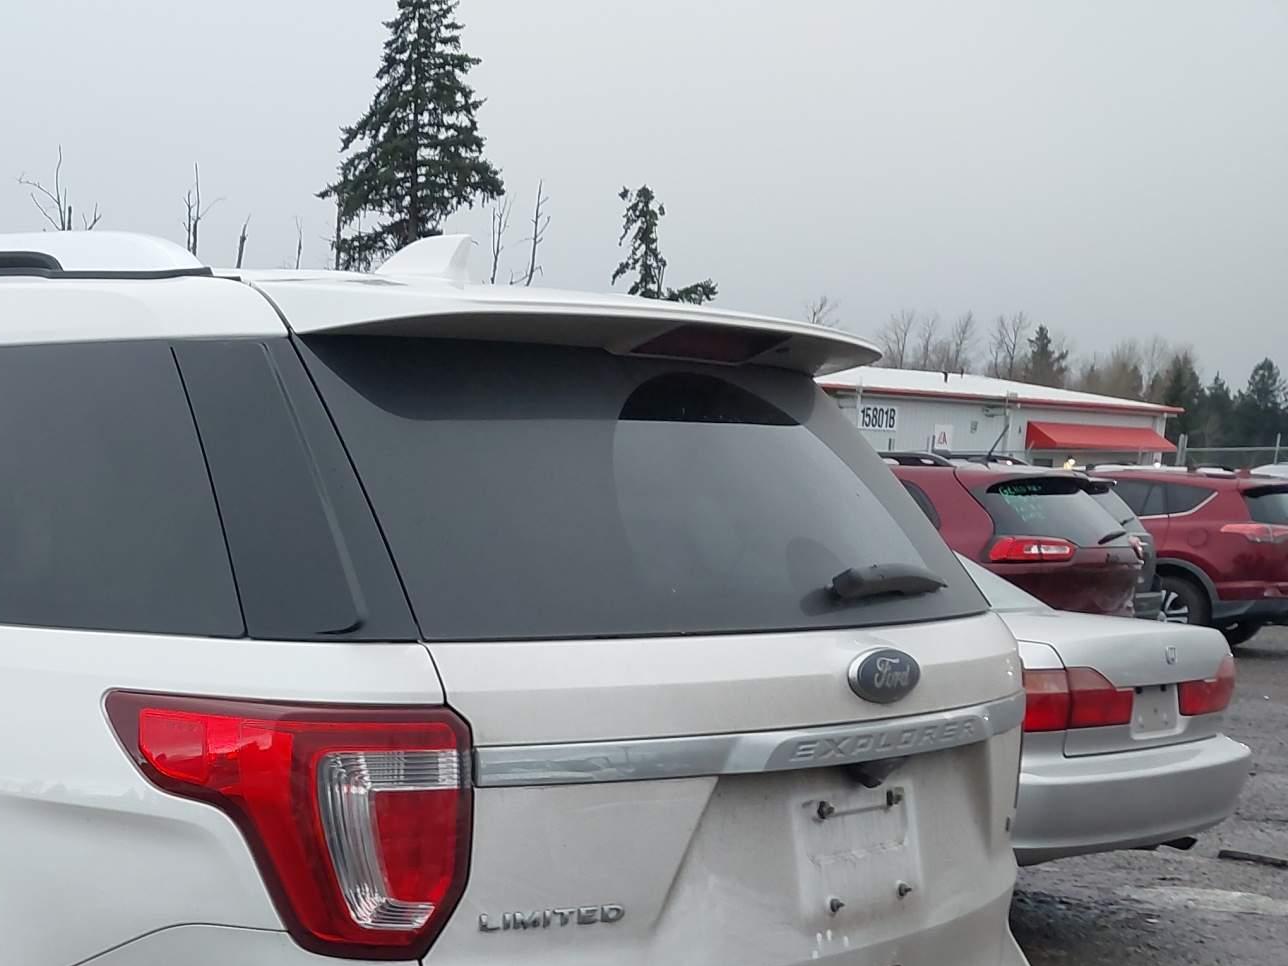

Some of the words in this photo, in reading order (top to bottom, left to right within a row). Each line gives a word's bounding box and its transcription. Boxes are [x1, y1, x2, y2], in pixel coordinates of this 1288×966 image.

[860, 406, 897, 429] 15801B
[874, 656, 911, 688] Ford
[789, 721, 974, 762] EXPLORER
[479, 903, 626, 932] LIMITED
